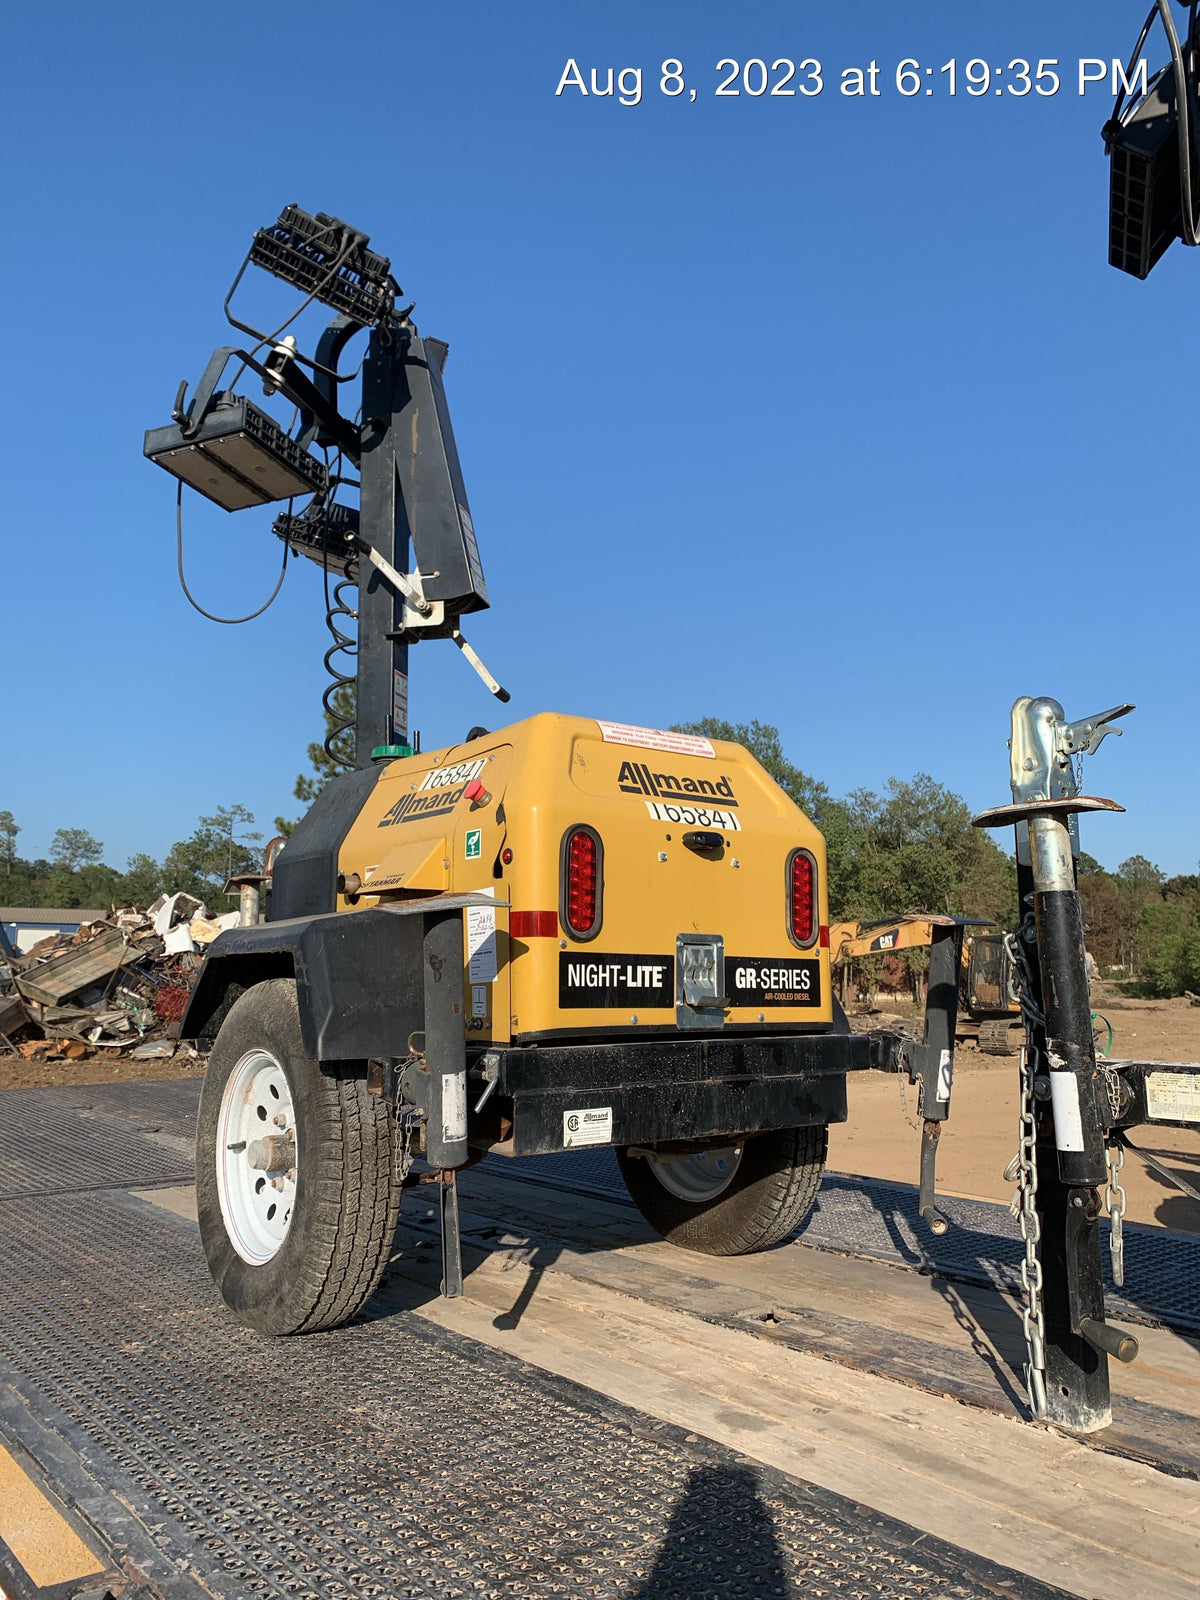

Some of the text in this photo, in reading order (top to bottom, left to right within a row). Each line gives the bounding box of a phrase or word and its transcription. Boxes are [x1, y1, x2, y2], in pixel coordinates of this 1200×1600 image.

[422, 759, 486, 791] 165841
[618, 761, 735, 798] Allmand
[379, 780, 471, 826] Allmand
[651, 802, 738, 831] 165841
[879, 935, 894, 949] CAT
[567, 963, 664, 988] NIGHT-LITE
[735, 967, 811, 990] GR-SERIES
[764, 992, 811, 1001] AIR-COOLED DIESEL
